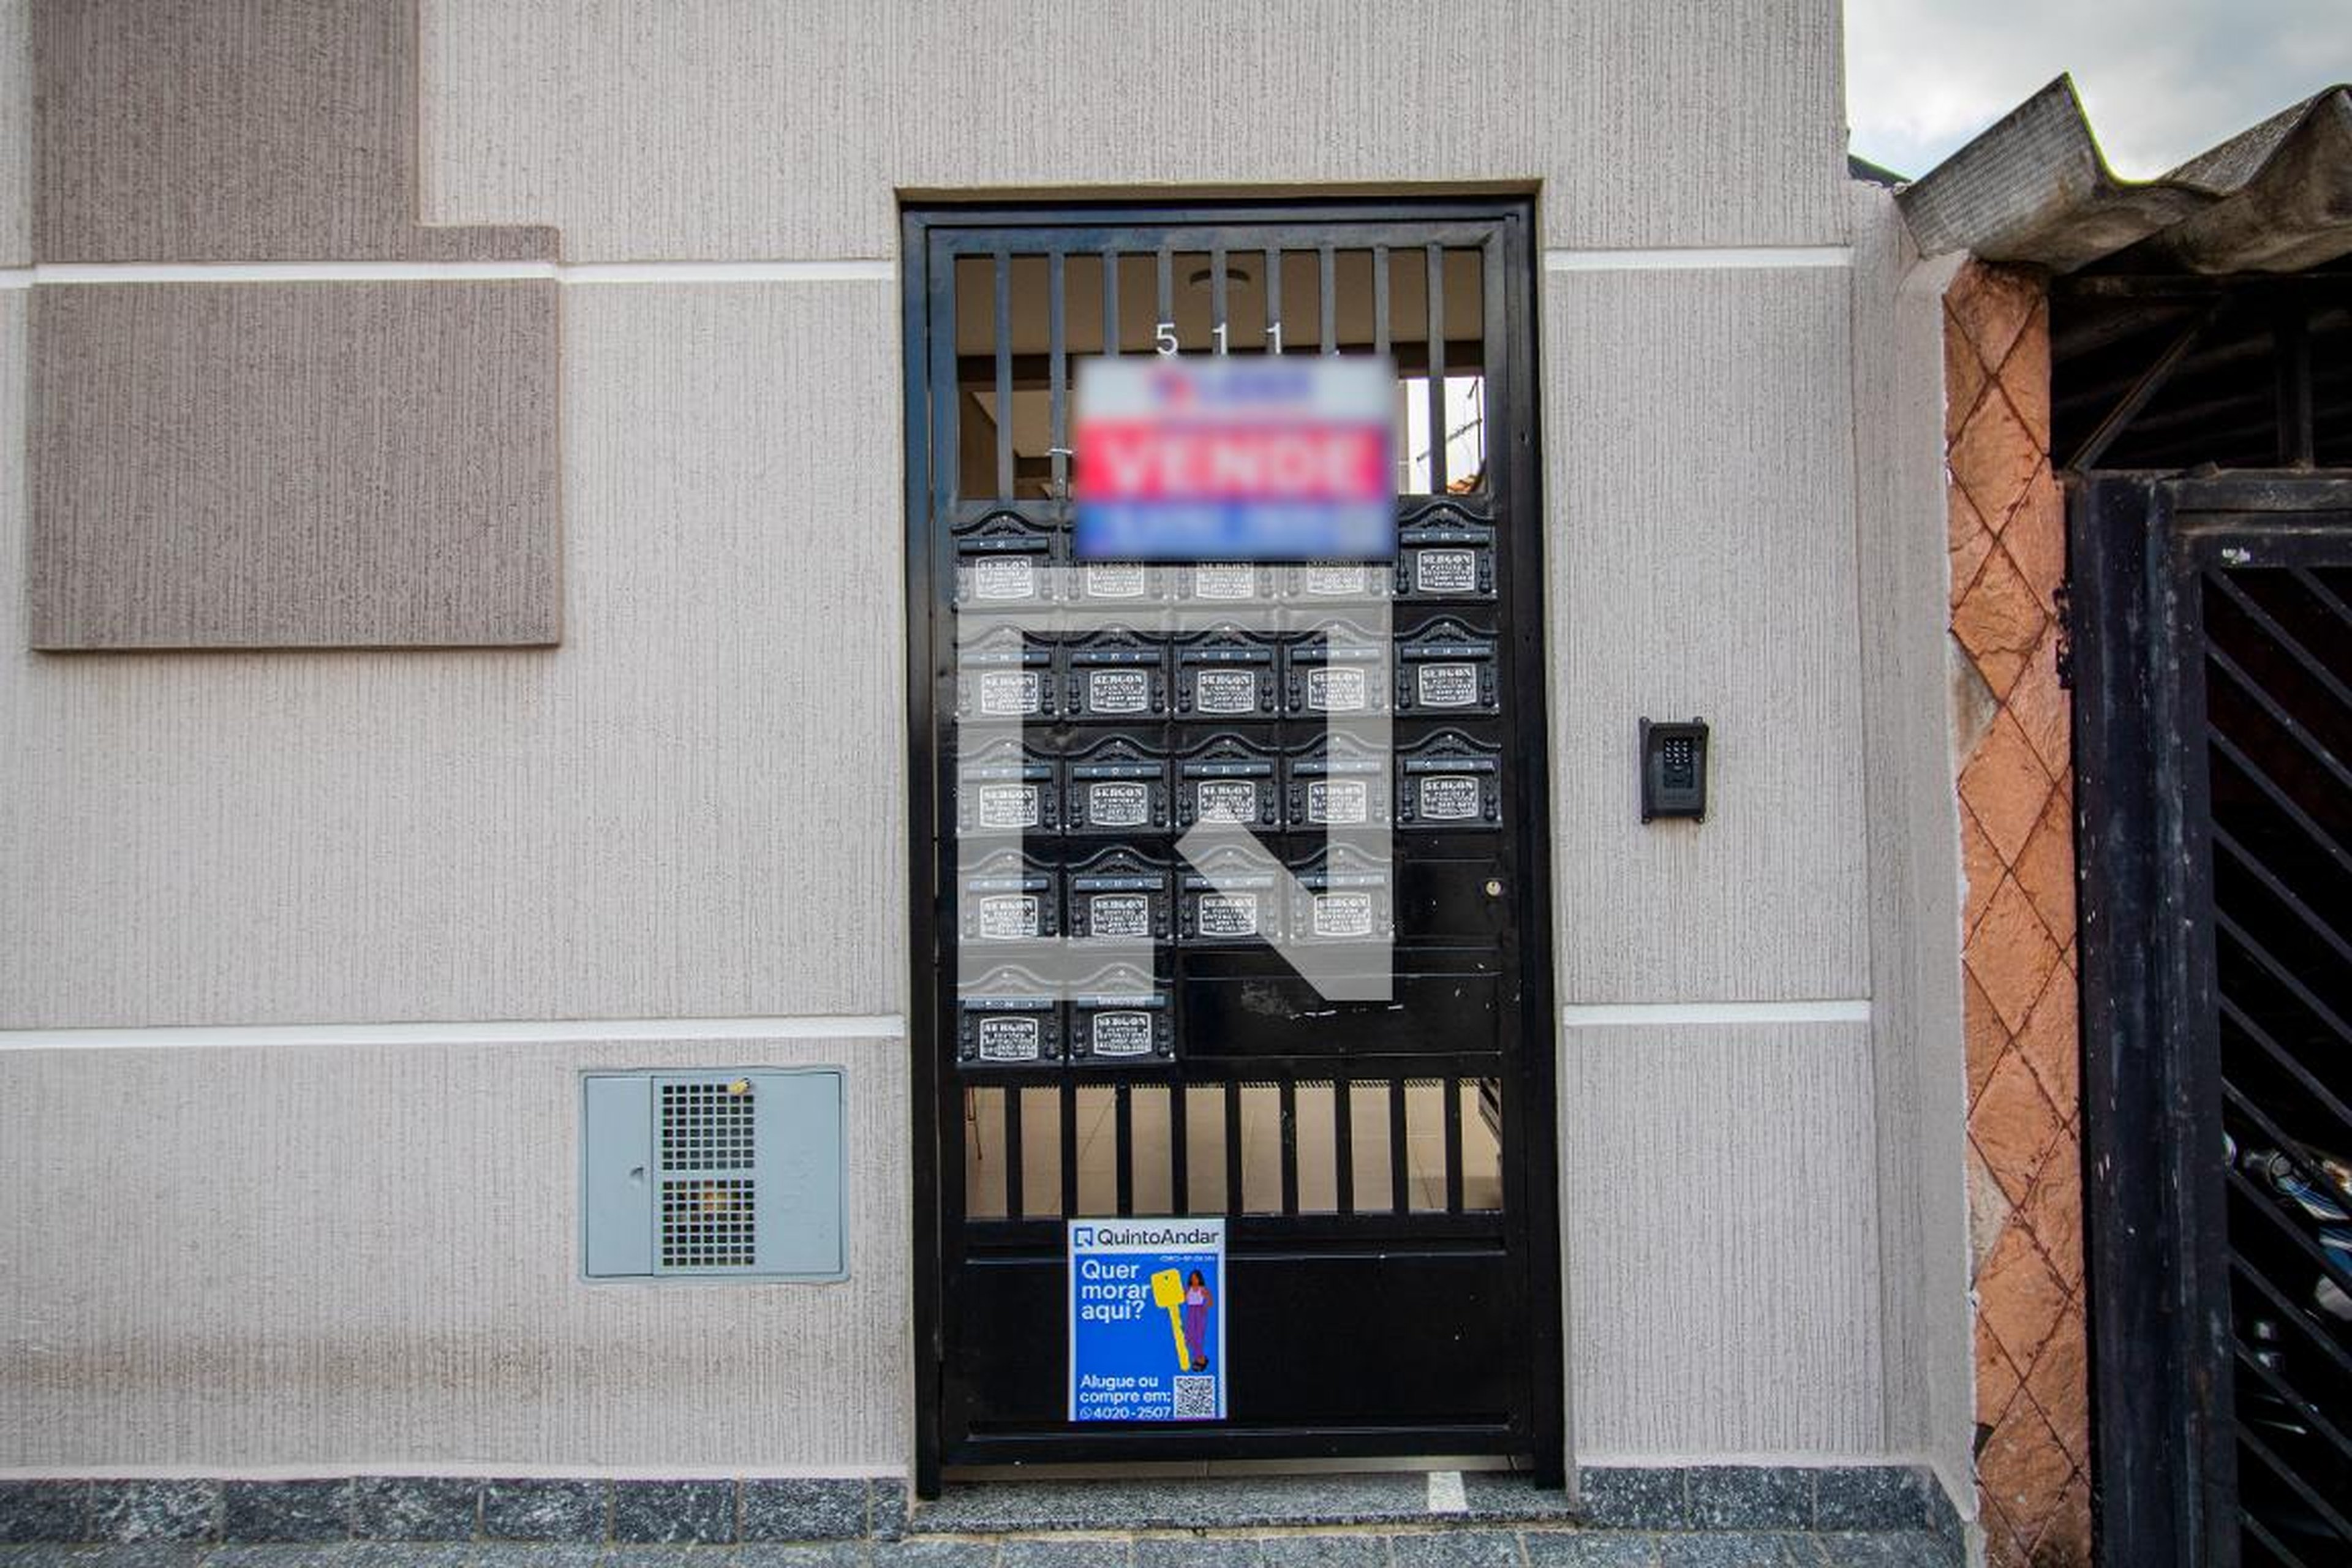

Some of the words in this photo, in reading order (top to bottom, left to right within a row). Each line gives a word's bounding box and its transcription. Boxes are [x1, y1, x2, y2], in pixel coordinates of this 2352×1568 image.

[1097, 1228, 1219, 1246] QuintoAndar
[1081, 1260, 1140, 1280] Quer
[1081, 1284, 1150, 1299] morar
[1081, 1300, 1145, 1323] aqui?
[1079, 1374, 1135, 1391] Alugue
[1138, 1376, 1159, 1387] ou
[1079, 1392, 1140, 1405] compre
[1142, 1392, 1171, 1403] em:
